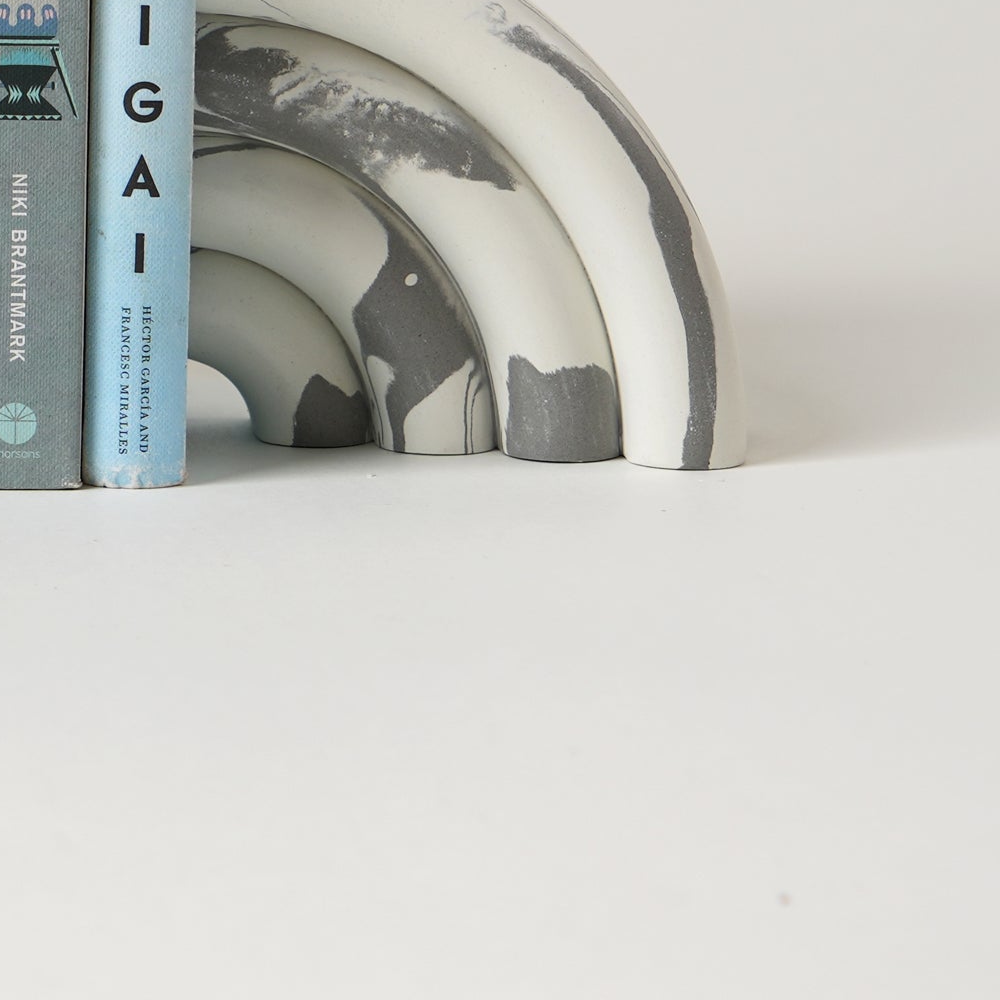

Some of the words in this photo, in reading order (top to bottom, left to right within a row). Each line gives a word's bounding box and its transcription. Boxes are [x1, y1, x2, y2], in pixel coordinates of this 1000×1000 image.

[11, 173, 28, 219] NIKI
[10, 229, 28, 364] BRANTMARK
[119, 306, 132, 380] FRANCESC
[141, 305, 154, 364] HÉCTOR
[118, 384, 130, 456] MIRALLES
[139, 367, 152, 421] GARCÍA
[139, 425, 149, 454] AND
